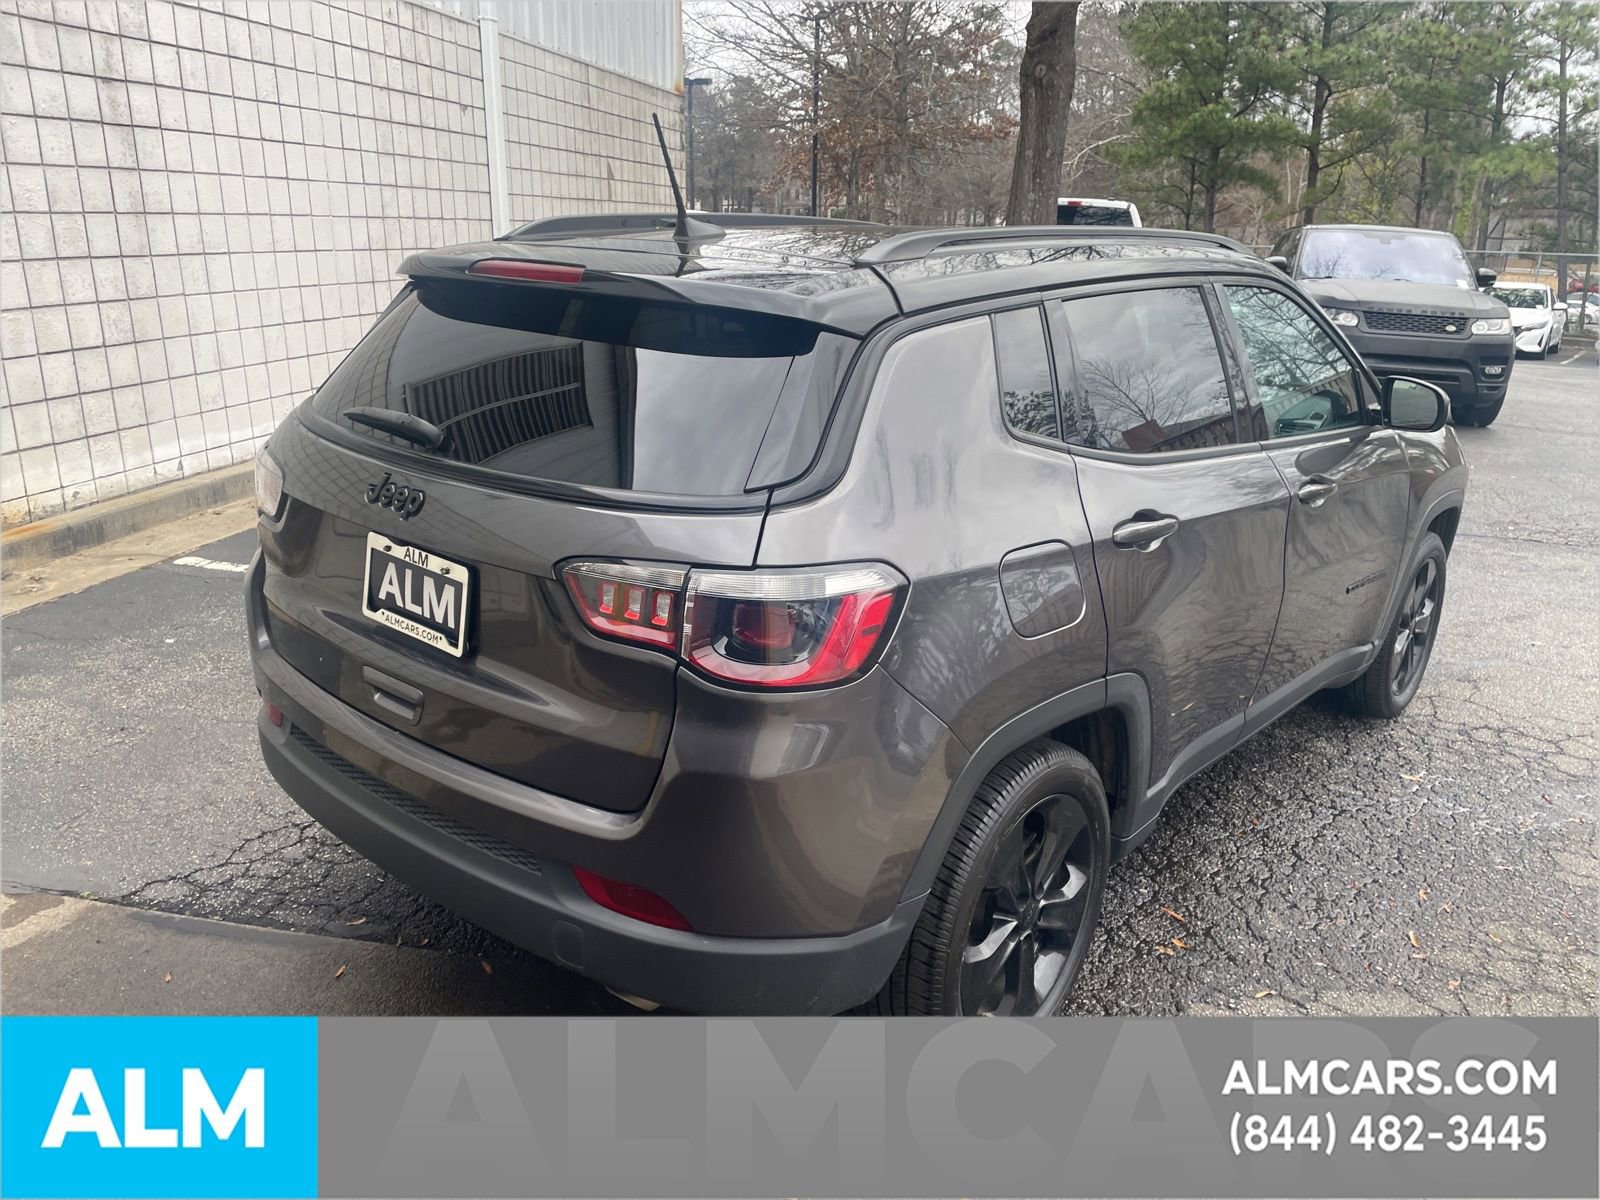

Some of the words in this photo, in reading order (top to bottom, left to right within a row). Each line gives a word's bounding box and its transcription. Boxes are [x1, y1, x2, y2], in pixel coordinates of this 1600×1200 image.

[364, 472, 426, 521] Jeep
[403, 546, 429, 568] ALM
[378, 561, 456, 630] ALM
[384, 613, 440, 644] ALMCARS.COM
